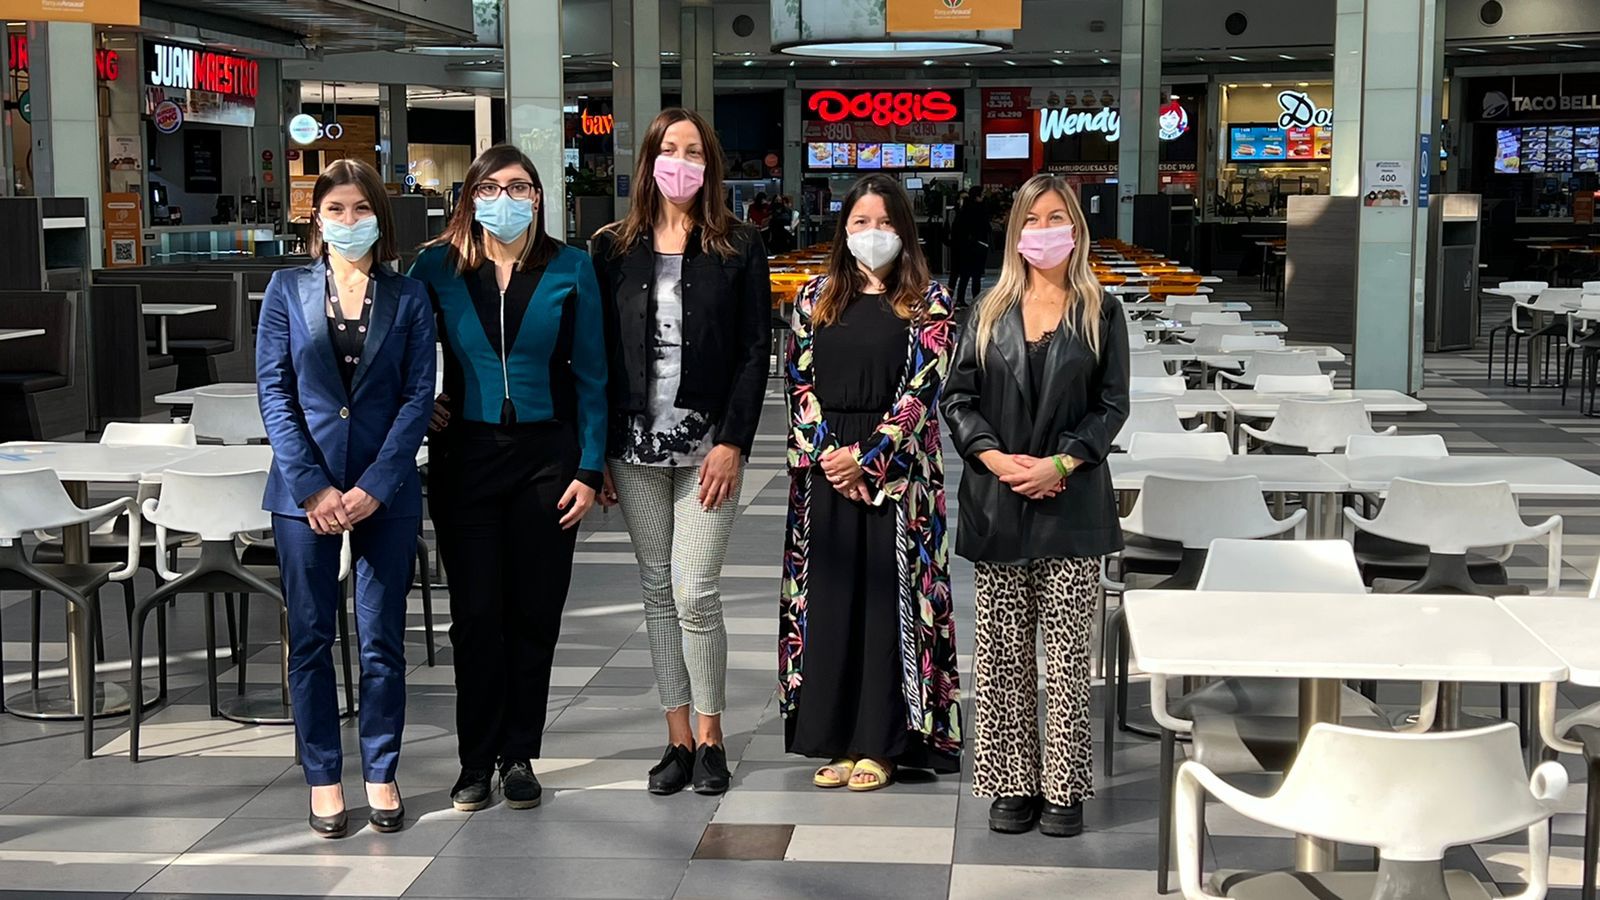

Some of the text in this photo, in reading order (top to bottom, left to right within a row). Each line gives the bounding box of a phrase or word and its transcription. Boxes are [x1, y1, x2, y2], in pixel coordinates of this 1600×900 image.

[151, 44, 258, 97] JUAN MAESTRO
[1512, 94, 1600, 111] TACO BELL
[1040, 107, 1120, 143] Wendy
[1048, 164, 1107, 173] HAMBURGUESAS
[1158, 163, 1195, 171] ESDE 1969
[1380, 174, 1397, 182] 400
